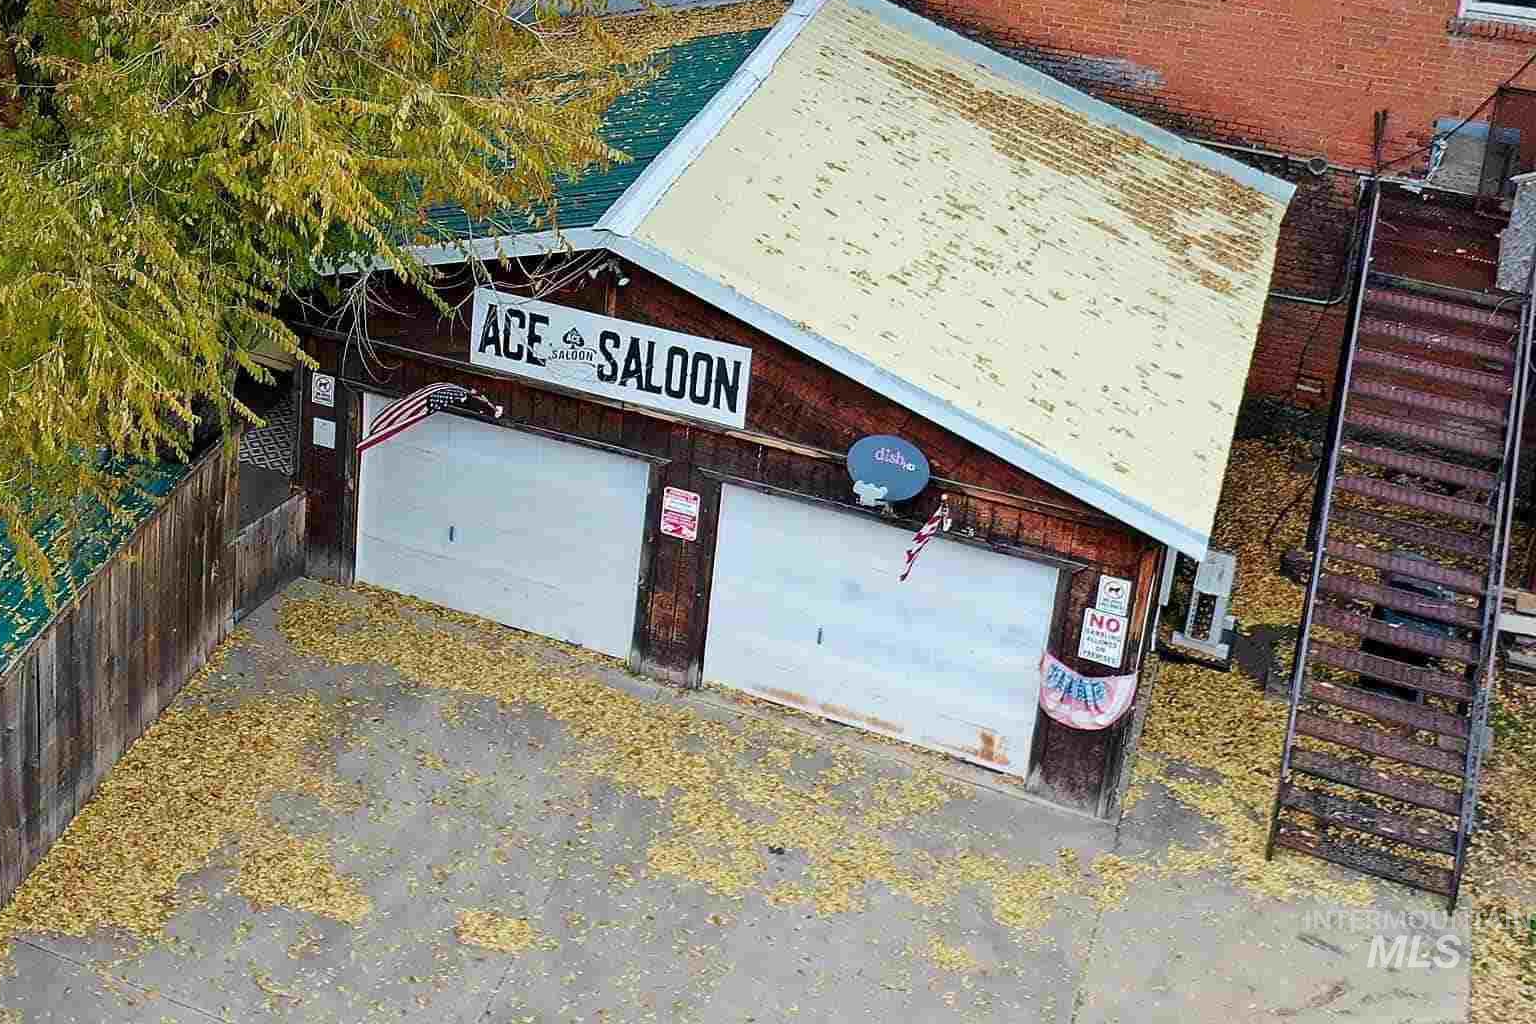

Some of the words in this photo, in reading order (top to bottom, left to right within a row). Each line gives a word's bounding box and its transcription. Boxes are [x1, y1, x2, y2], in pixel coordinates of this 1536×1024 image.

[478, 303, 550, 367] ACE
[597, 330, 741, 414] SALOON
[551, 349, 593, 361] SALOON
[874, 447, 904, 465] dish
[1090, 613, 1121, 633] NO
